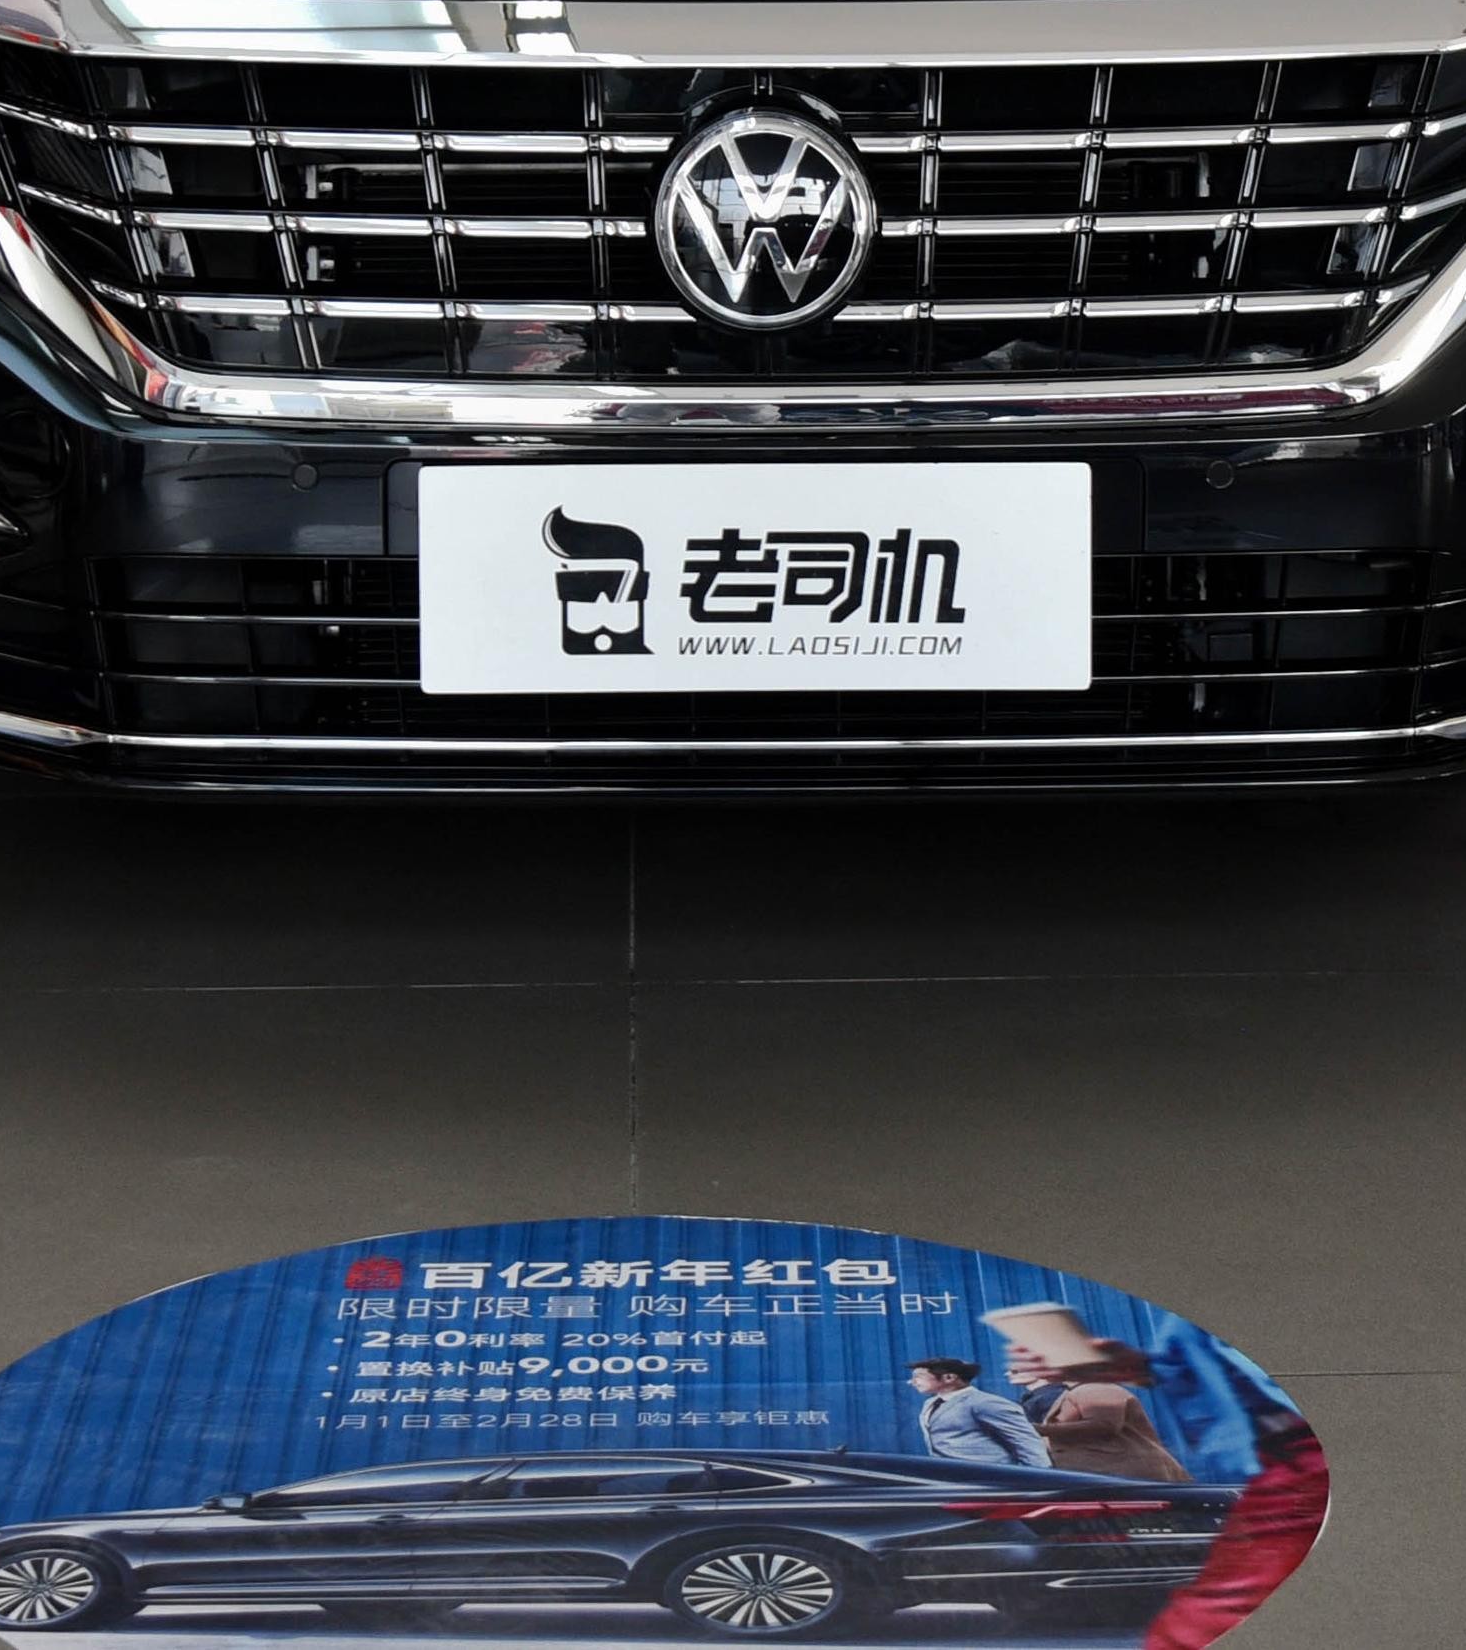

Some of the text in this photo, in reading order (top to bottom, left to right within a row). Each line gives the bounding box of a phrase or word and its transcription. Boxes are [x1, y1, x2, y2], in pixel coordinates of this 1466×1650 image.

[678, 528, 967, 624] 老司机
[677, 636, 964, 657] WWW.LAOSIJI.COM
[419, 1258, 899, 1290] 百亿新年红包
[336, 1291, 960, 1322] 限时限量 购车正当时
[360, 1328, 770, 1350] 2年0利率 20%首付起
[355, 1354, 711, 1378] 置换补贴9,000元
[348, 1382, 678, 1405] 原店终身免费保养
[314, 1408, 831, 1432] 1月1日至2月28日 购车享钜惠
